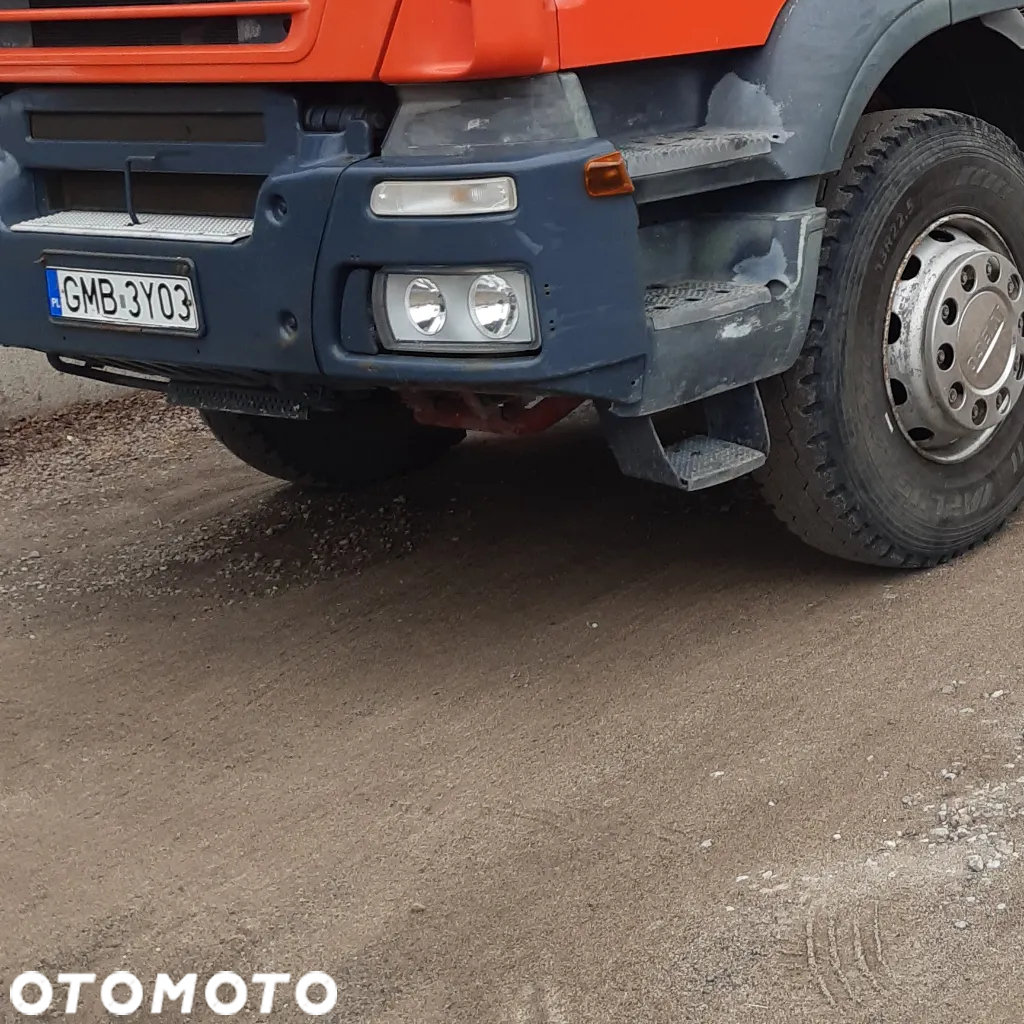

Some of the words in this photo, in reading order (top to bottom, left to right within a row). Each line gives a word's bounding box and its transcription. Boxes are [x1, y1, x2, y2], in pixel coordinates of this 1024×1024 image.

[51, 296, 61, 309] PL
[63, 275, 118, 316] GMB
[124, 280, 192, 322] 3Y03
